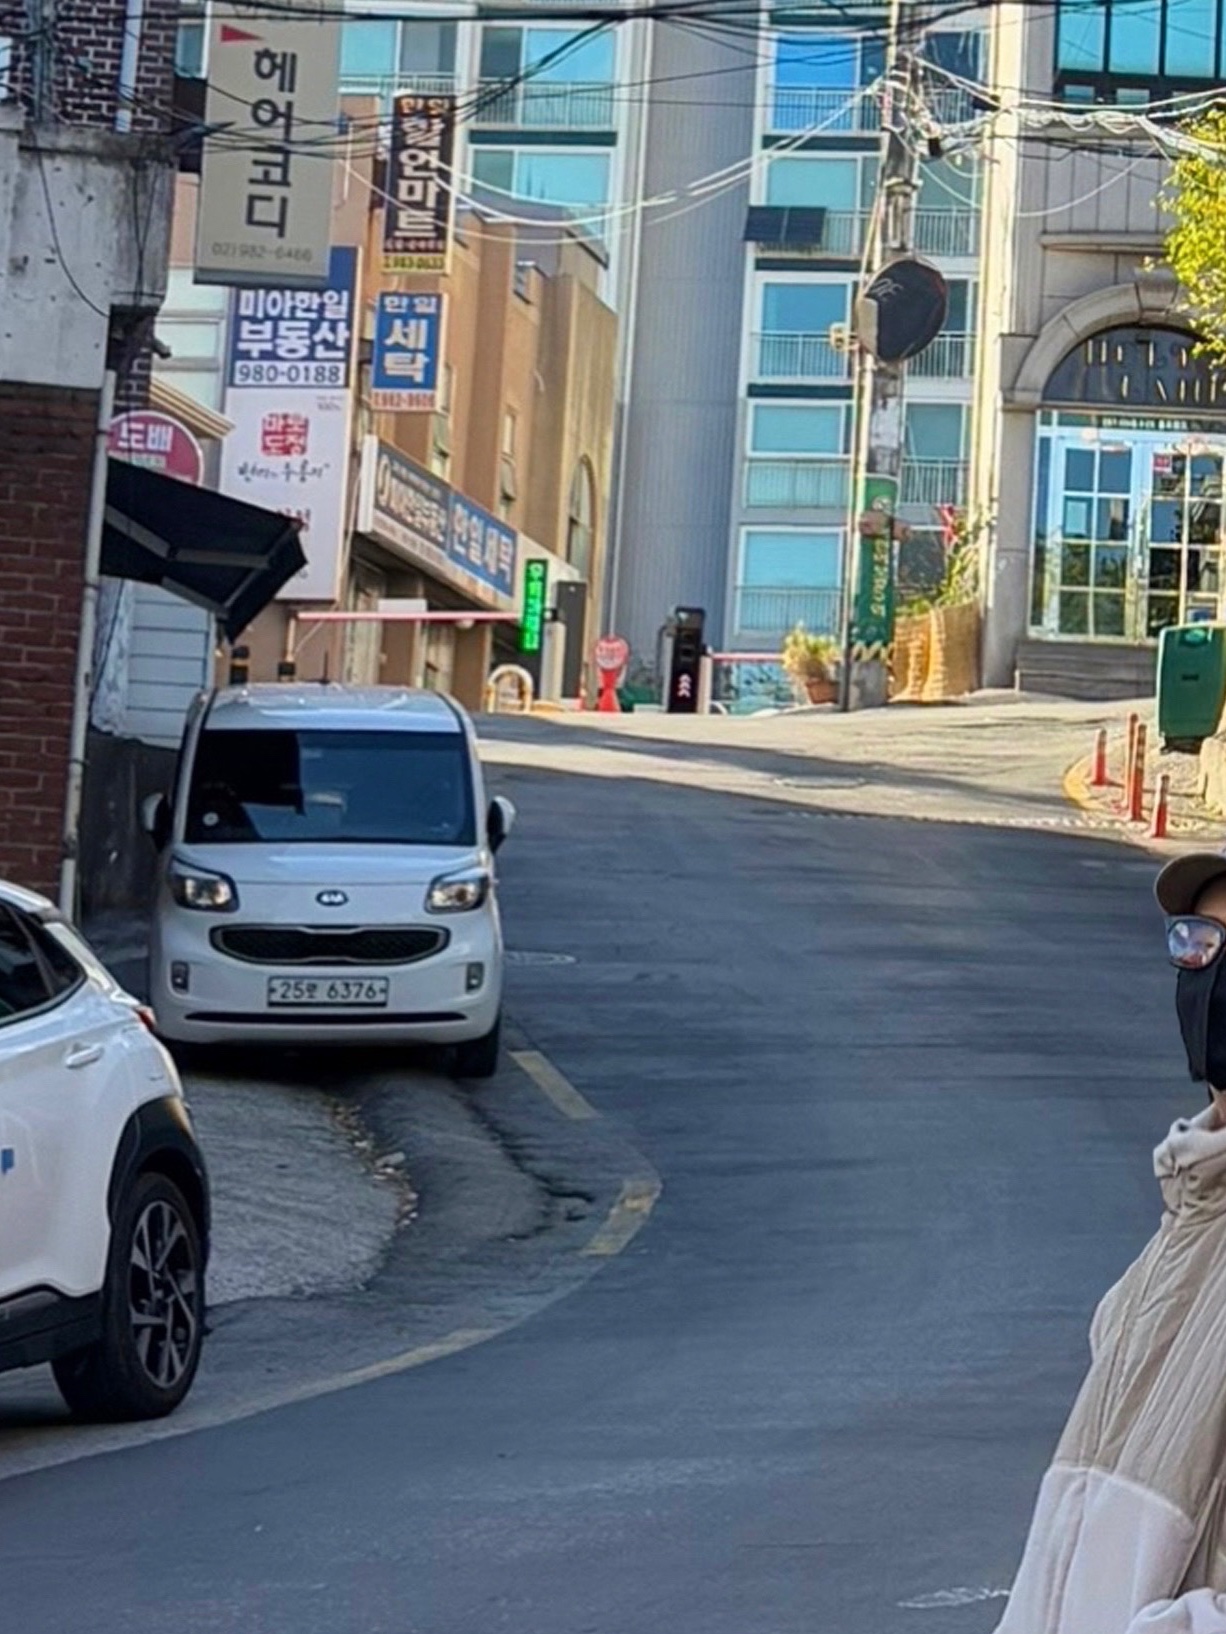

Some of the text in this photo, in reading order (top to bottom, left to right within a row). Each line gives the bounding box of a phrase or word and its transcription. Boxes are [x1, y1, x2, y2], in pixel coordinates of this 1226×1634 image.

[246, 48, 297, 238] 헤어코디
[239, 289, 349, 319] 미아한일
[237, 321, 349, 359] 부동산
[383, 318, 430, 383] 세탁
[238, 363, 341, 384] 980-0188
[117, 421, 174, 452] 도배
[326, 982, 377, 1000] 6376
